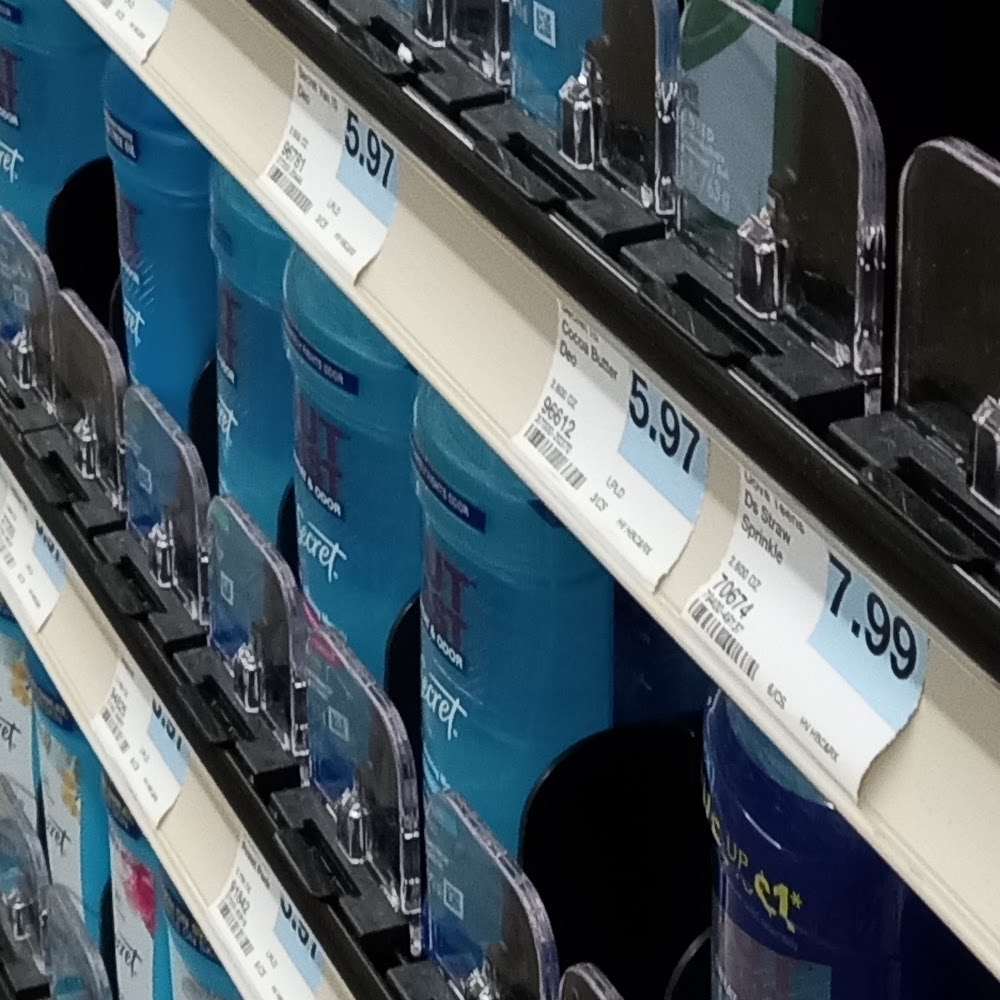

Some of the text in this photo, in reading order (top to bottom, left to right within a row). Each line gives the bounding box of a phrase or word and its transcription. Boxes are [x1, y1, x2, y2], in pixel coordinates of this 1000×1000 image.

[344, 107, 395, 190] 5.97
[559, 339, 578, 368] Deo
[561, 318, 590, 355] Cocoa
[590, 345, 619, 381] Butter
[541, 395, 577, 440] 96612
[628, 369, 701, 475] 5.97
[314, 485, 343, 518] ODOR
[743, 487, 792, 546] Ds Straw
[740, 513, 784, 566] Sprinkle
[712, 571, 755, 619] 70674
[827, 551, 918, 680] 7.99
[436, 633, 465, 672] ODOR
